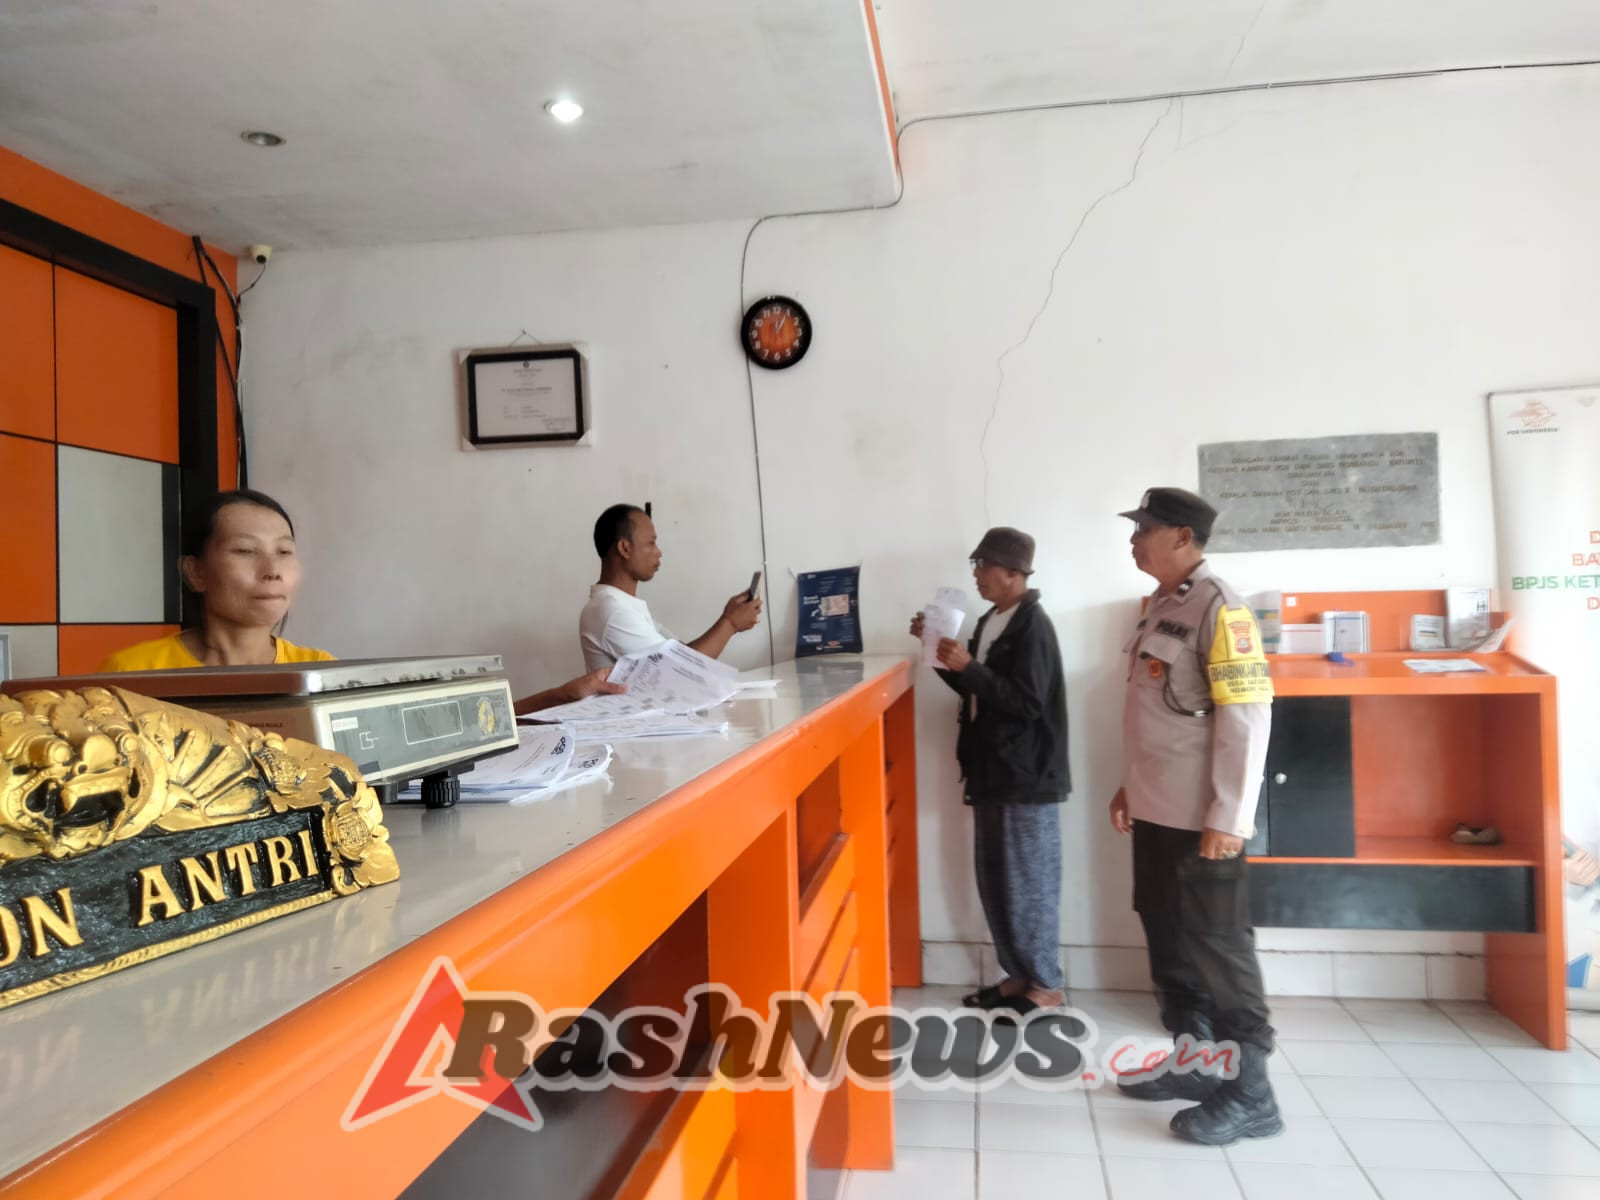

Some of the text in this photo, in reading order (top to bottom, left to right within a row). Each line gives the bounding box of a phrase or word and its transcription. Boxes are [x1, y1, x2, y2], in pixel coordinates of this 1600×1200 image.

[1572, 552, 1600, 567] BA
[1512, 574, 1600, 590] BPJS KET
[137, 830, 319, 928] ANTRI
